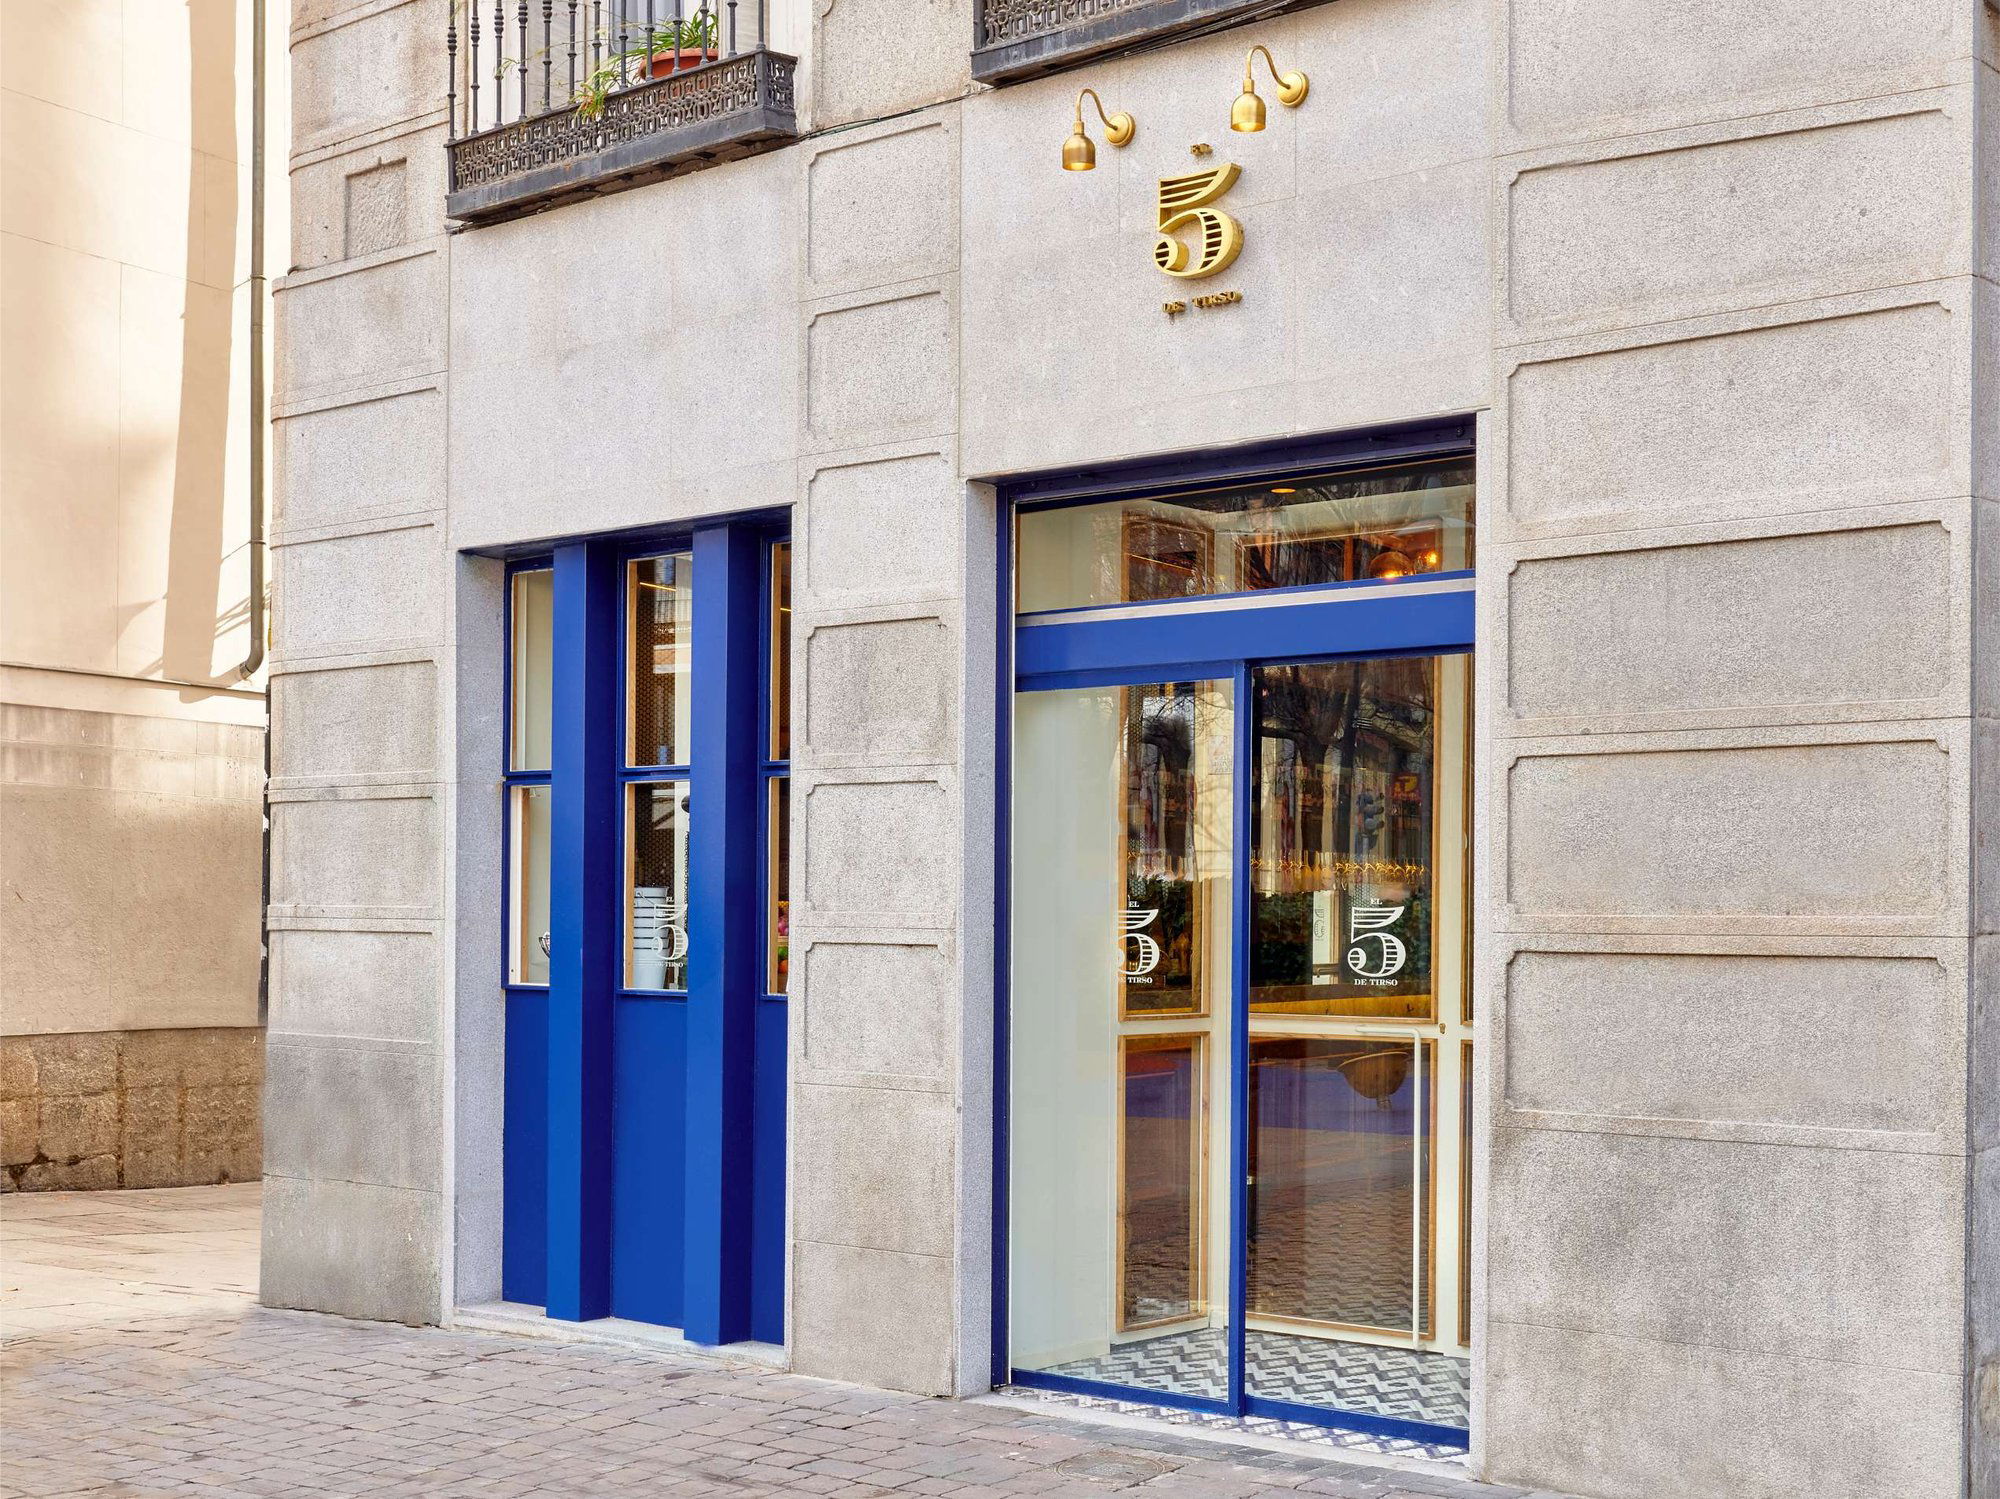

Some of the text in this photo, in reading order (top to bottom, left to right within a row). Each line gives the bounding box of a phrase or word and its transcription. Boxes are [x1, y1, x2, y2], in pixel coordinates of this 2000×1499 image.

[1153, 162, 1244, 278] 5
[652, 904, 689, 960] 5
[1347, 906, 1406, 977] 5
[1127, 976, 1153, 984] TIRSO
[1369, 978, 1398, 986] TIRSO
